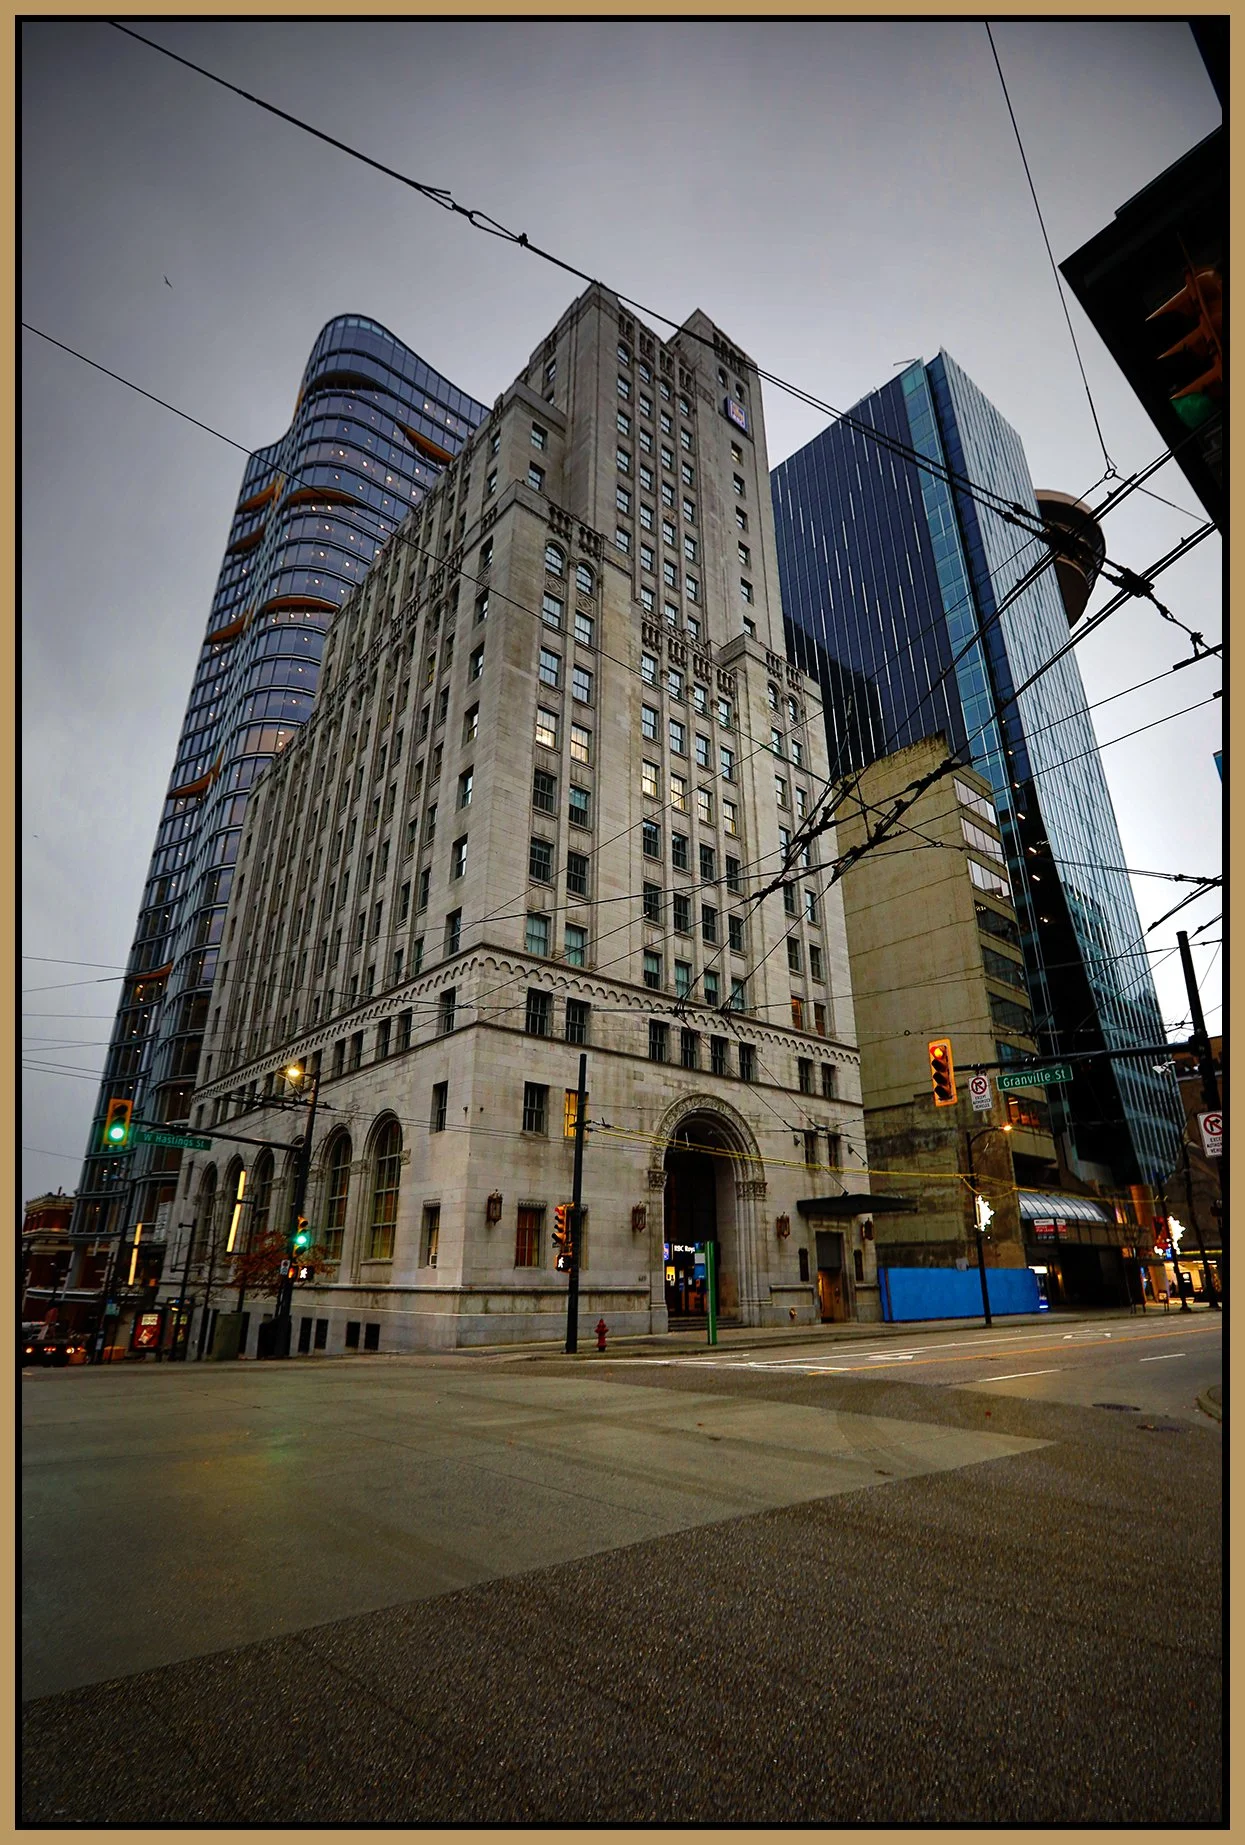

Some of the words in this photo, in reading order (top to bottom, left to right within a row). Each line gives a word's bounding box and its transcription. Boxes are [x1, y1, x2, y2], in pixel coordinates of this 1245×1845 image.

[1003, 1072, 1051, 1088] Granville
[1055, 1069, 1066, 1080] St
[143, 1132, 153, 1142] W
[155, 1135, 193, 1148] Hastings
[196, 1139, 205, 1148] St
